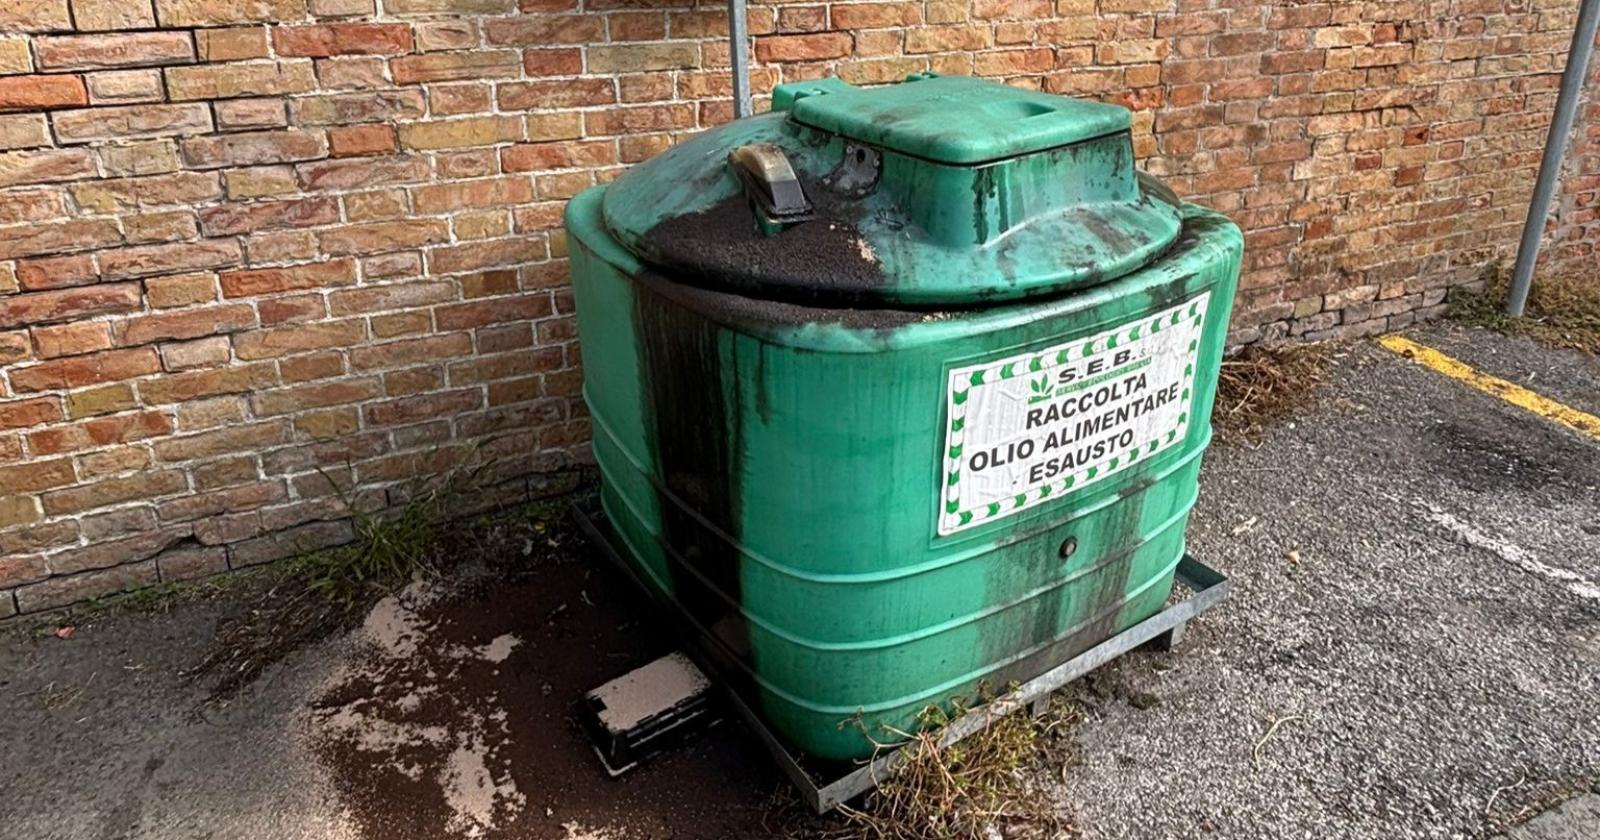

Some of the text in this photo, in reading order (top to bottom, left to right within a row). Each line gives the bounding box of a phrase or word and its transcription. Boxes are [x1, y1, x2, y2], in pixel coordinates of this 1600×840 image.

[1058, 349, 1136, 384] S.E.B.
[969, 381, 1179, 472] OLIO ALIMENTARE
[1026, 373, 1147, 430] RACCOLTA
[1029, 428, 1134, 484] ESAUSTO
